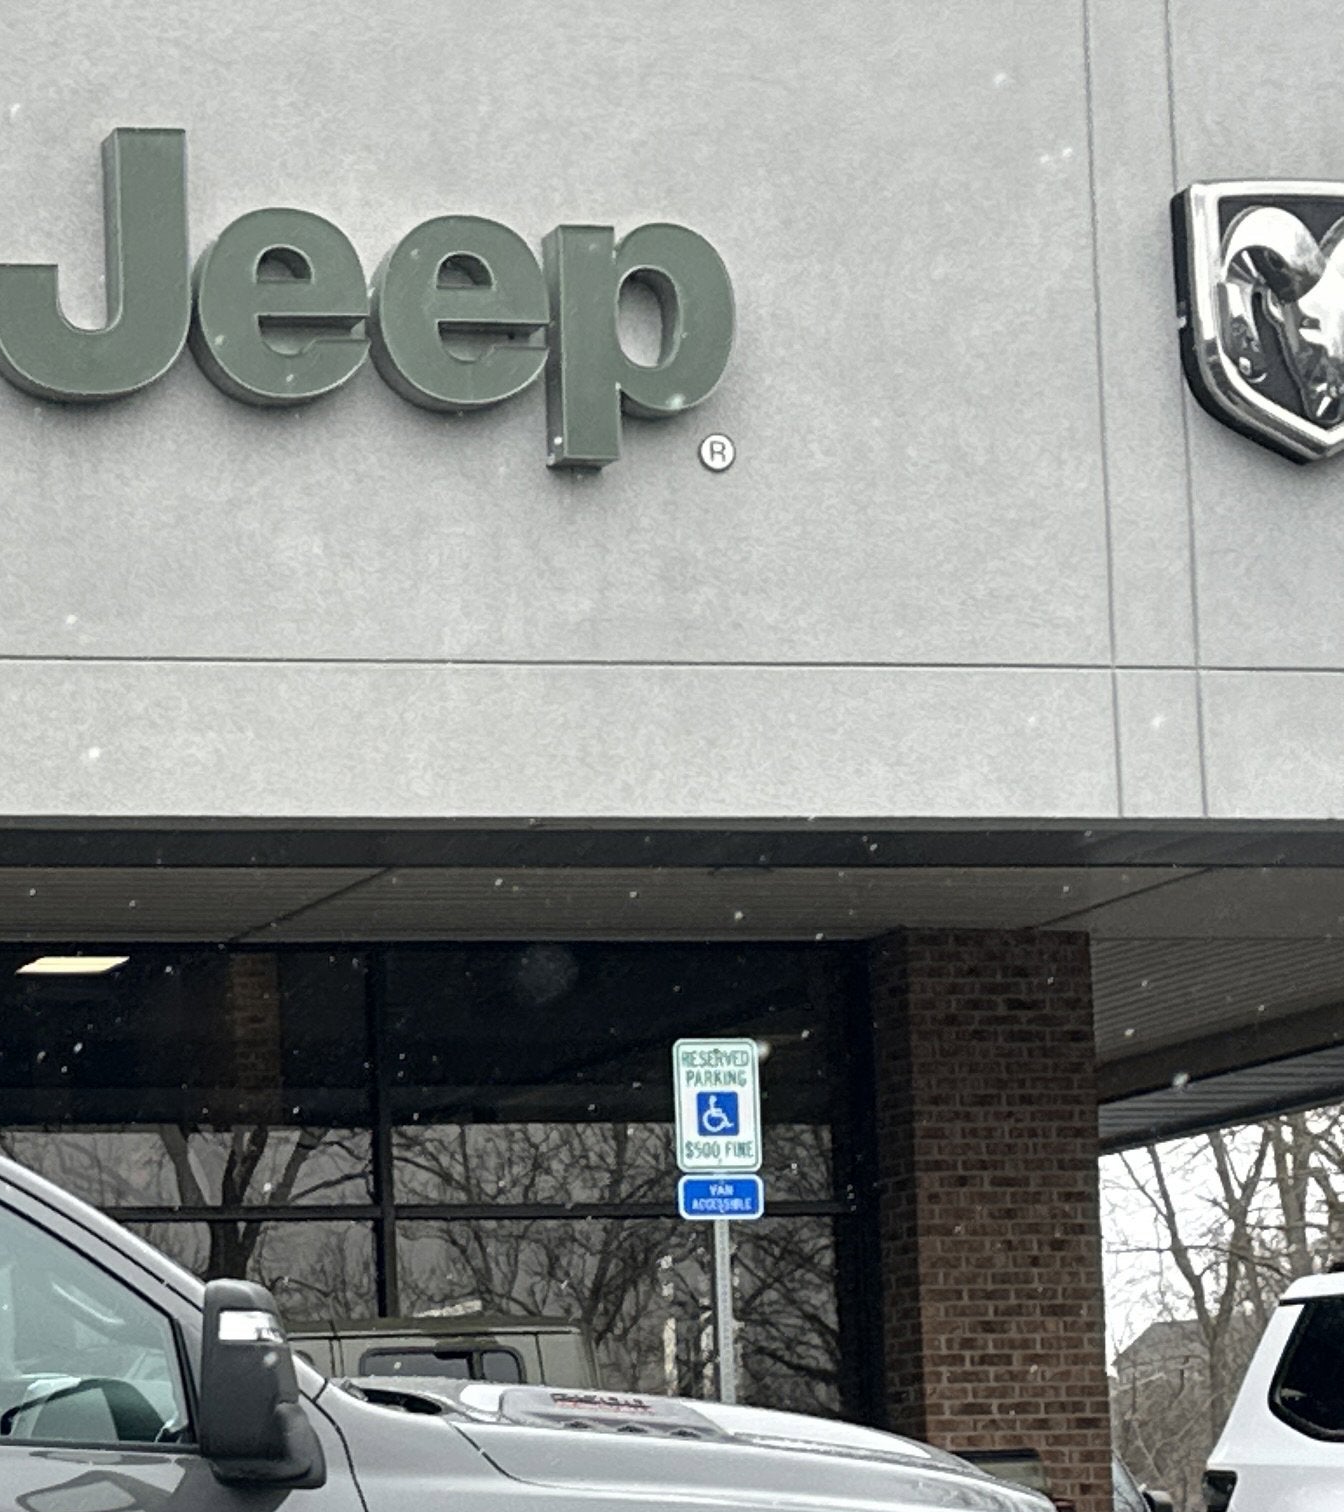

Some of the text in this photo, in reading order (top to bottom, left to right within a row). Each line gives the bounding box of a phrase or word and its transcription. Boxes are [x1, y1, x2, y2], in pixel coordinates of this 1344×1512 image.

[681, 1050, 749, 1068] RESERVED
[686, 1071, 747, 1087] PARKING
[685, 1141, 754, 1159] $500 FINE
[709, 1184, 733, 1196] VAN
[692, 1198, 752, 1212] ACCESSIBLE
